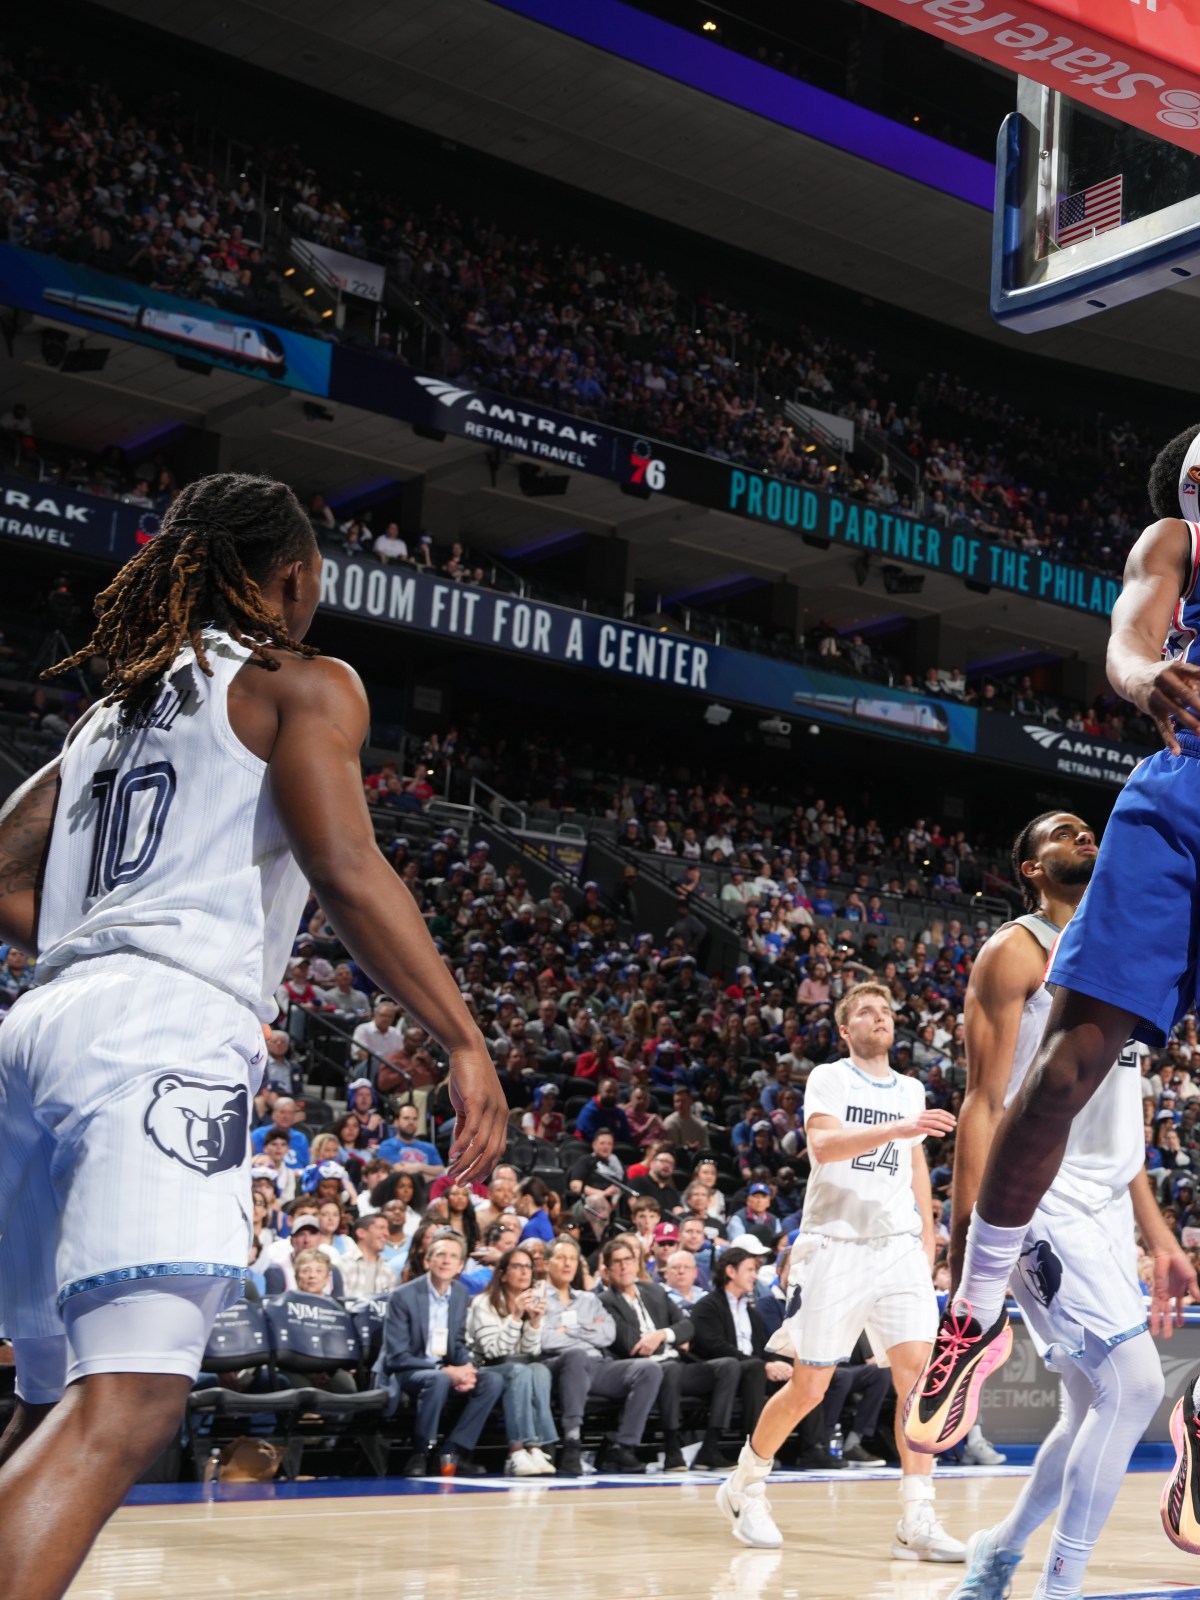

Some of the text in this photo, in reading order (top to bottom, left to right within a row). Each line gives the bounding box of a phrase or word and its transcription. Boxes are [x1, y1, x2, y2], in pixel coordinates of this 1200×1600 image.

[466, 399, 597, 447] AMTRAK
[464, 421, 586, 467] RETRAIN TRAVEL
[0, 487, 89, 523] RAK
[730, 470, 1123, 616] PROUD PARTNER OF THE PHILAD
[430, 585, 481, 636] FIT
[492, 600, 551, 654] FOR
[564, 618, 584, 661] A
[598, 625, 709, 689] CENTER
[1057, 759, 1101, 778] RETRAIN
[86, 761, 177, 897] 10
[851, 1141, 899, 1176] 24
[287, 1302, 318, 1319] NJM
[982, 1389, 1057, 1408] BETMGM
